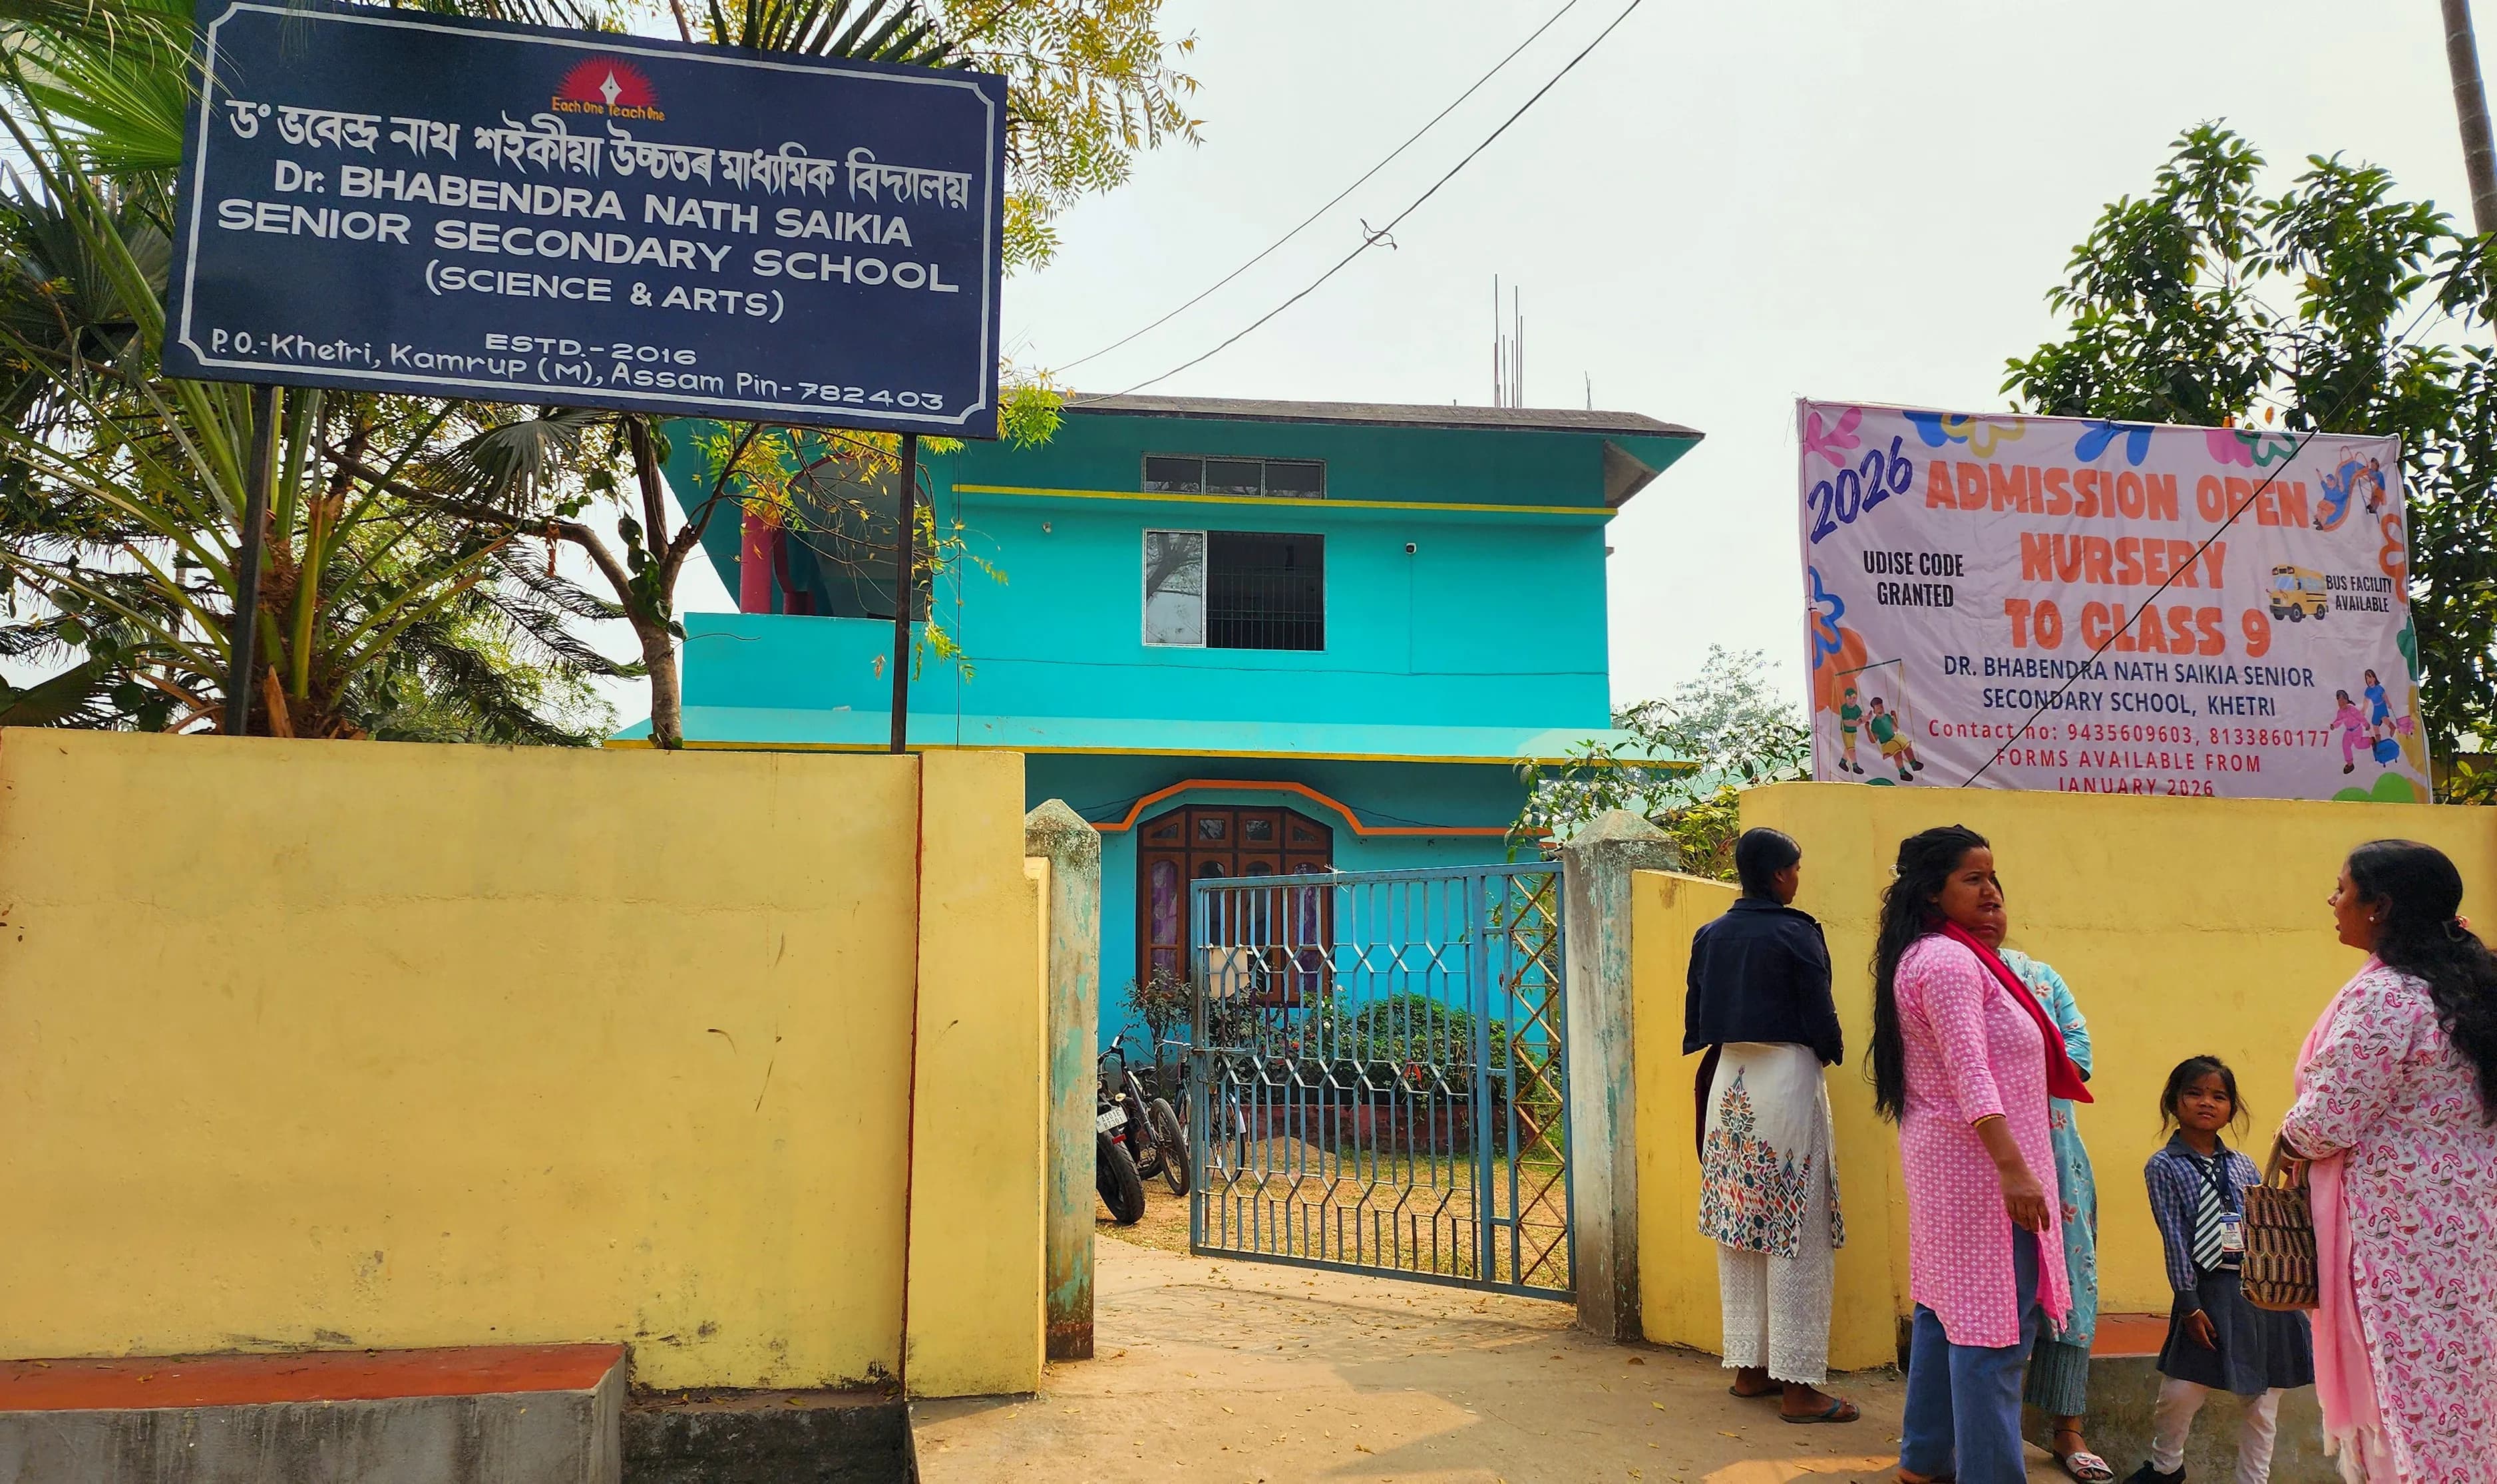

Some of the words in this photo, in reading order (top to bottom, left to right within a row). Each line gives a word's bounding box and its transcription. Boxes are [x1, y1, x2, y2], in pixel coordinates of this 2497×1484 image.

[552, 97, 581, 112] Each
[584, 102, 604, 114] One
[609, 103, 645, 119] Teach
[648, 106, 666, 122] One
[389, 116, 461, 162] নাথ
[474, 110, 605, 180] শইকীয়া
[607, 119, 715, 188] উচ্চতৰ
[719, 142, 837, 199] মাধ্যমিক
[845, 146, 972, 213] বিদ্যালয়
[274, 159, 325, 194] Dr.
[340, 165, 626, 224] BHABENDRA
[644, 194, 759, 235] NATH
[775, 208, 913, 248] SAIKIA
[218, 199, 411, 244] SENIOR
[434, 220, 731, 273] SECONDARY
[753, 250, 960, 293] SCHOOL
[425, 259, 612, 303] (SCIENCE
[630, 283, 652, 307] &
[661, 287, 785, 323] ARTS)
[391, 343, 527, 380] Kamrup
[611, 361, 725, 395] Assam
[1808, 436, 1913, 544] 2026
[1925, 461, 2179, 522] ADMISSION
[2197, 474, 2309, 528] OPEN
[1863, 550, 1913, 576] UDISE
[1920, 553, 1964, 577] CODE
[2020, 532, 2227, 590] NURSERY
[1877, 582, 1954, 608] GRANTED
[2326, 575, 2348, 591] BUS
[2350, 576, 2392, 594] FACILITY
[2335, 595, 2390, 613] AVAILABLE
[2005, 599, 2063, 649] TO
[2080, 601, 2226, 657] CLASS
[2241, 608, 2271, 658] 9
[1944, 655, 1977, 677] DR.
[1984, 656, 2108, 680] BHABENDRA
[2114, 660, 2168, 683] NATH
[2175, 664, 2239, 685] SAIKIA
[2244, 667, 2315, 687] SENIOR
[1983, 688, 2103, 711] SECONDARY
[2111, 692, 2197, 716] SCHOOL,
[2208, 696, 2275, 716] KHETRI
[1929, 719, 2015, 740] Contact
[2026, 722, 2057, 741] no:
[2067, 723, 2200, 746] 9435609603,
[2210, 729, 2329, 747] 8133860177
[1997, 750, 2068, 767] FORMS
[2080, 751, 2196, 771] AVAILABLE
[2206, 755, 2261, 772] FROM
[2167, 779, 2214, 797] 2026
